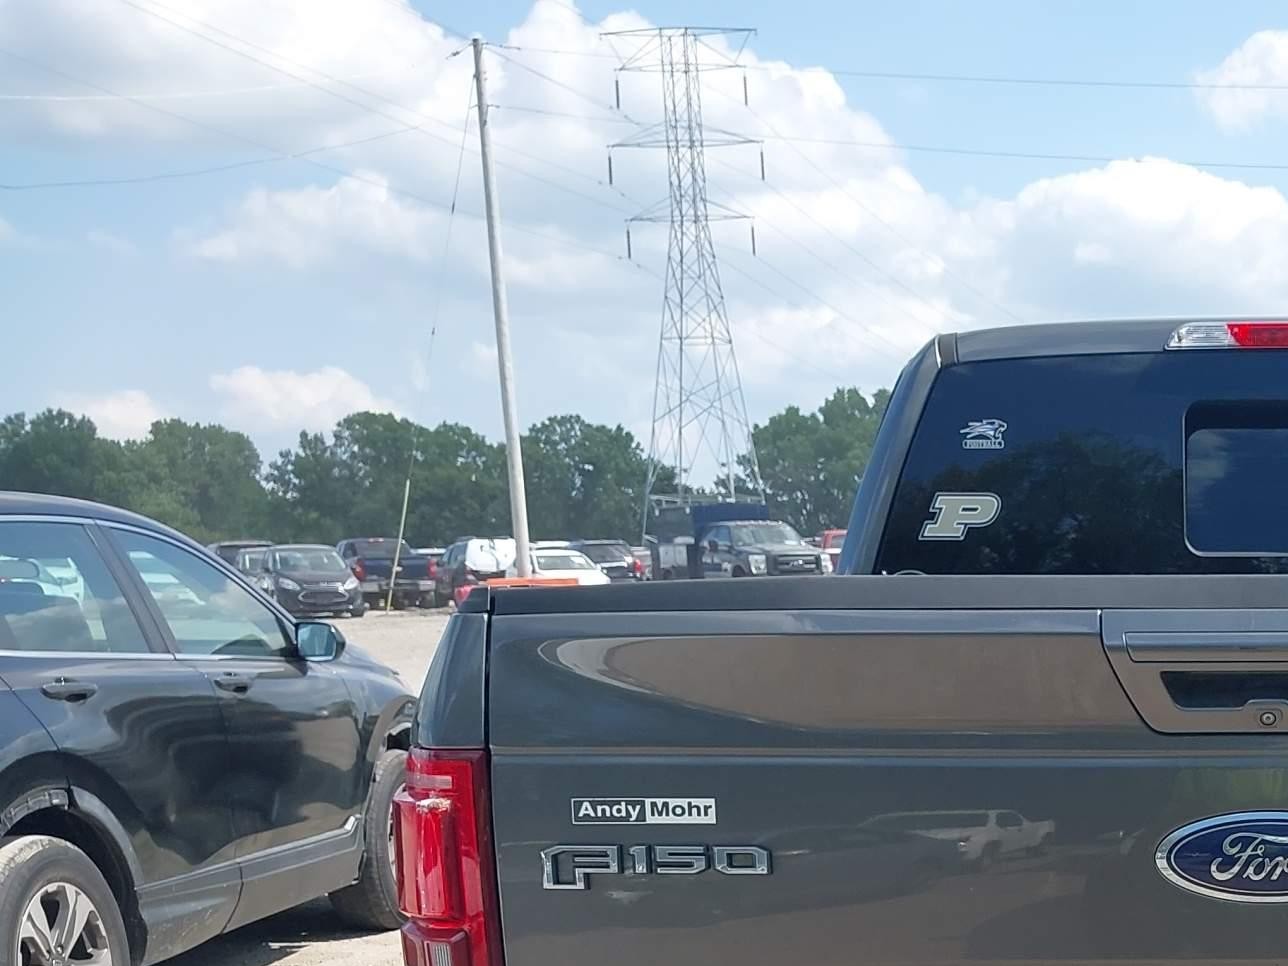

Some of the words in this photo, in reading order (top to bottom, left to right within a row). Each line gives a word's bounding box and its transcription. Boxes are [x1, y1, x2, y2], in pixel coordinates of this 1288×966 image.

[918, 491, 1002, 541] P
[577, 801, 641, 821] Andy
[650, 801, 713, 818] Mohr
